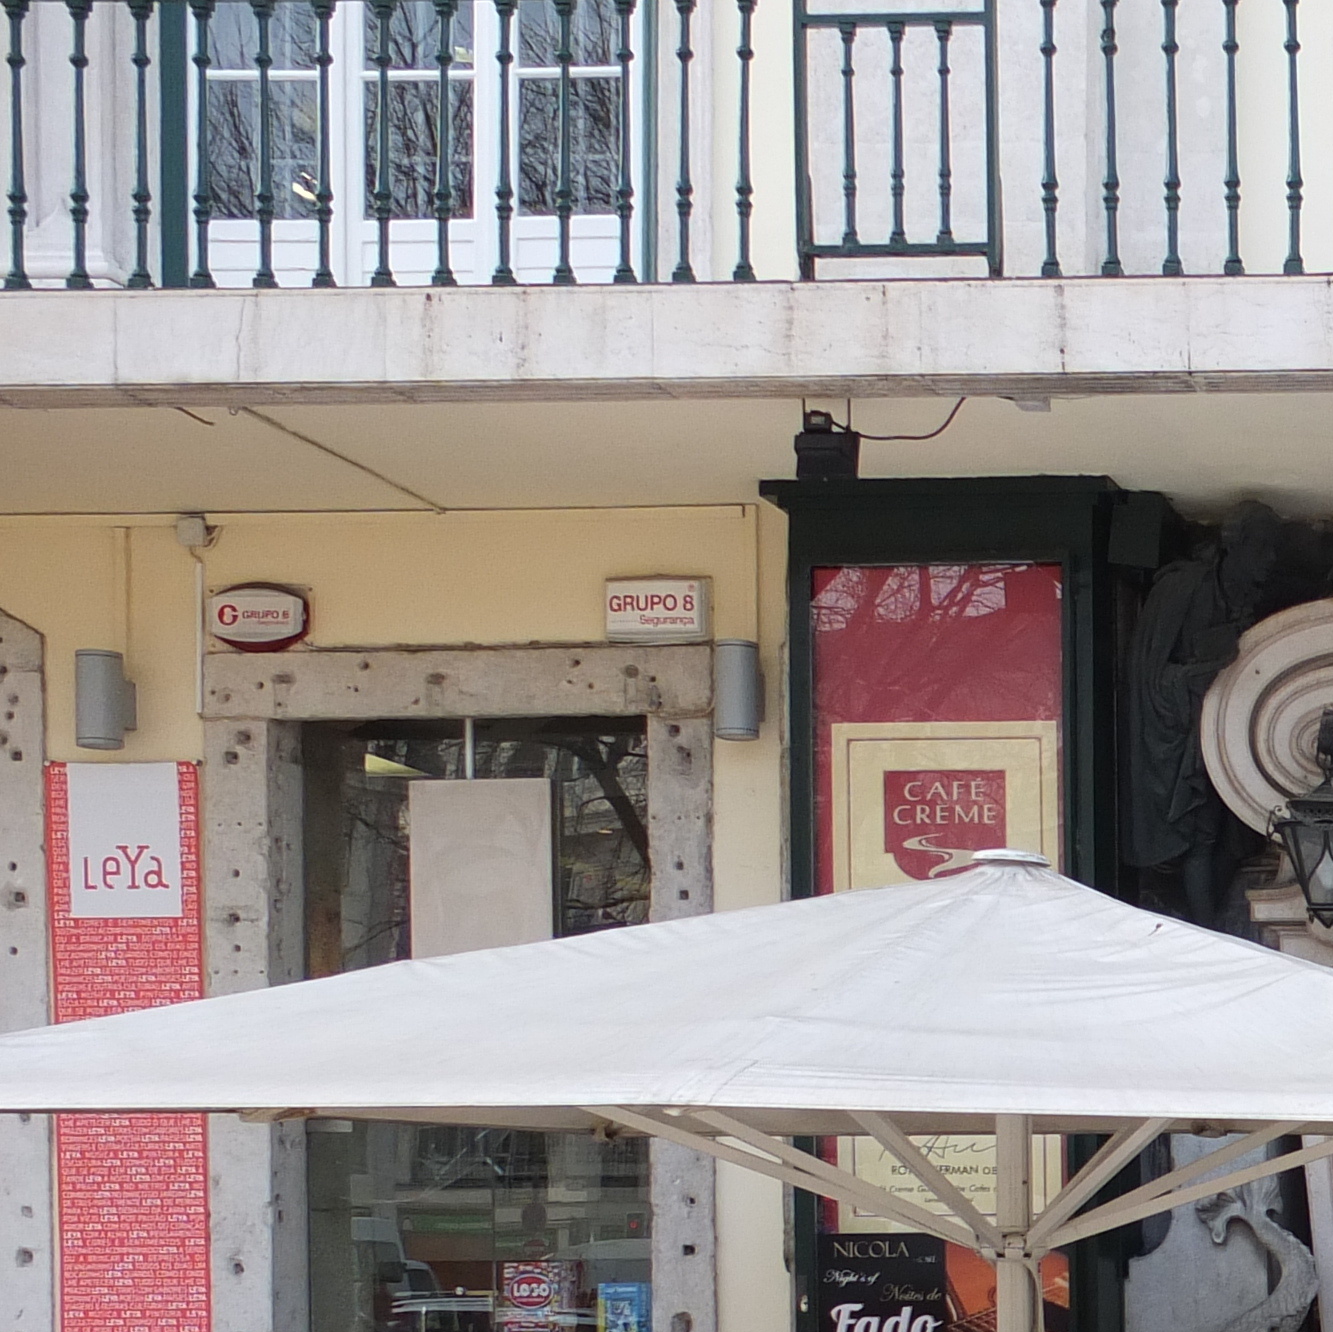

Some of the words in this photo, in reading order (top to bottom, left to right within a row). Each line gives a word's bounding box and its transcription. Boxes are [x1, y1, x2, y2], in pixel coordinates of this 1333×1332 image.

[609, 593, 678, 613] GRUPO
[682, 594, 695, 612] 8
[242, 610, 279, 619] GRUPO
[640, 614, 695, 627] Segurança
[903, 777, 985, 801] CAFÉ
[892, 801, 997, 825] CRÈME
[833, 1241, 909, 1258] NICOLA
[513, 1283, 549, 1297] LOGO
